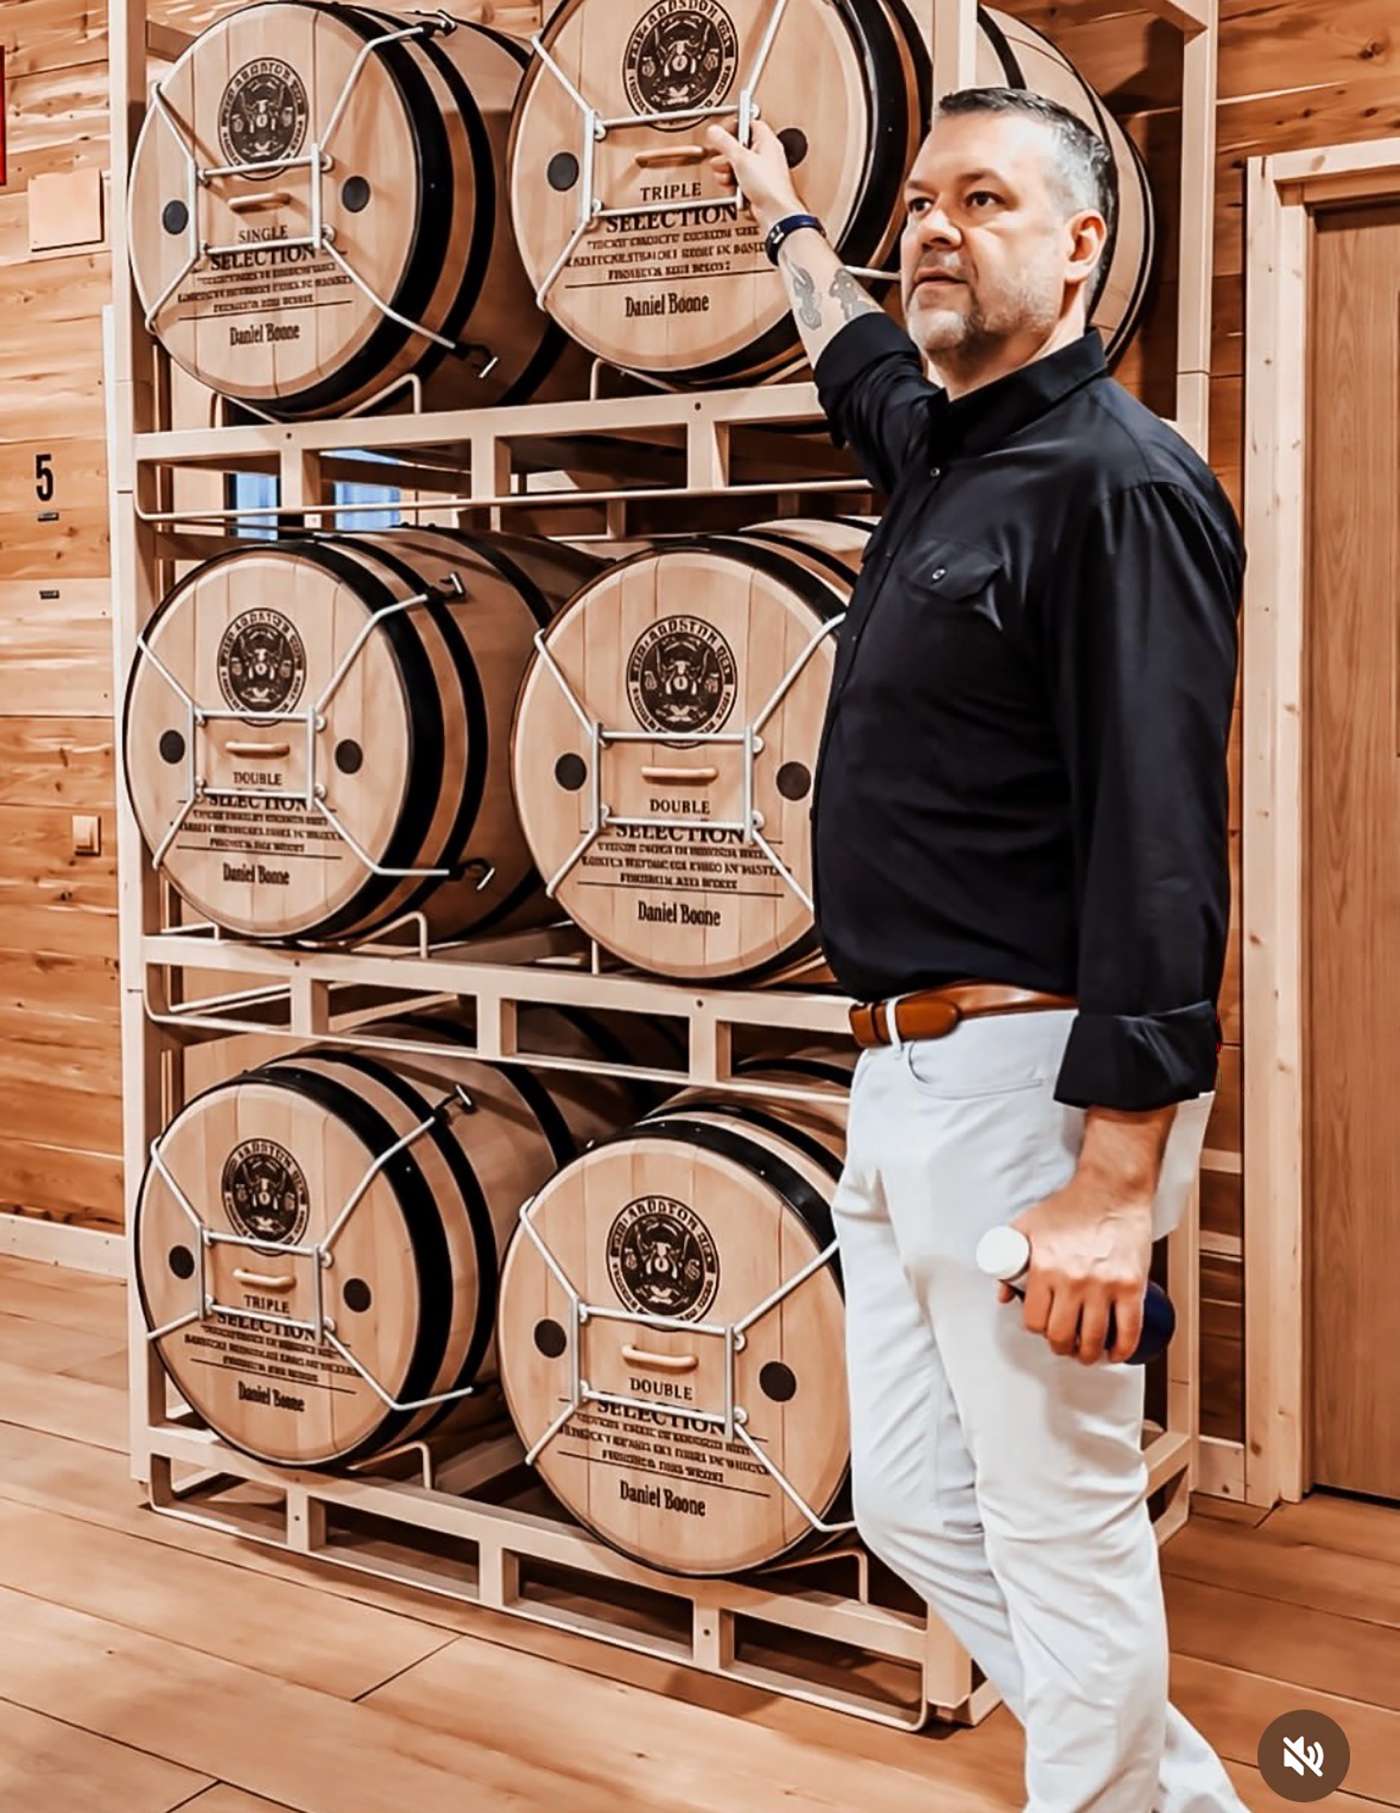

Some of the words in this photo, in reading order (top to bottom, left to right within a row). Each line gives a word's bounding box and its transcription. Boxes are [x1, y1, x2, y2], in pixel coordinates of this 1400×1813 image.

[640, 182, 702, 201] TRIPLE
[606, 203, 738, 233] SELECTION
[238, 224, 289, 243] SINGLE
[210, 244, 316, 271] SELECTION
[625, 293, 665, 318] Daniel
[668, 292, 710, 315] Boone
[229, 324, 264, 346] Daniel
[35, 453, 54, 502] 5
[233, 771, 283, 786] DOUBLE
[650, 798, 711, 815] DOUBLE
[222, 862, 256, 883] Daniel
[637, 899, 677, 923] Daniel
[680, 902, 721, 927] Boone
[243, 1294, 290, 1314] TRIPLE
[238, 1380, 271, 1406] Daniel
[629, 1377, 693, 1401] DOUBLE
[619, 1479, 661, 1508] Daniel
[664, 1488, 706, 1517] Boone
